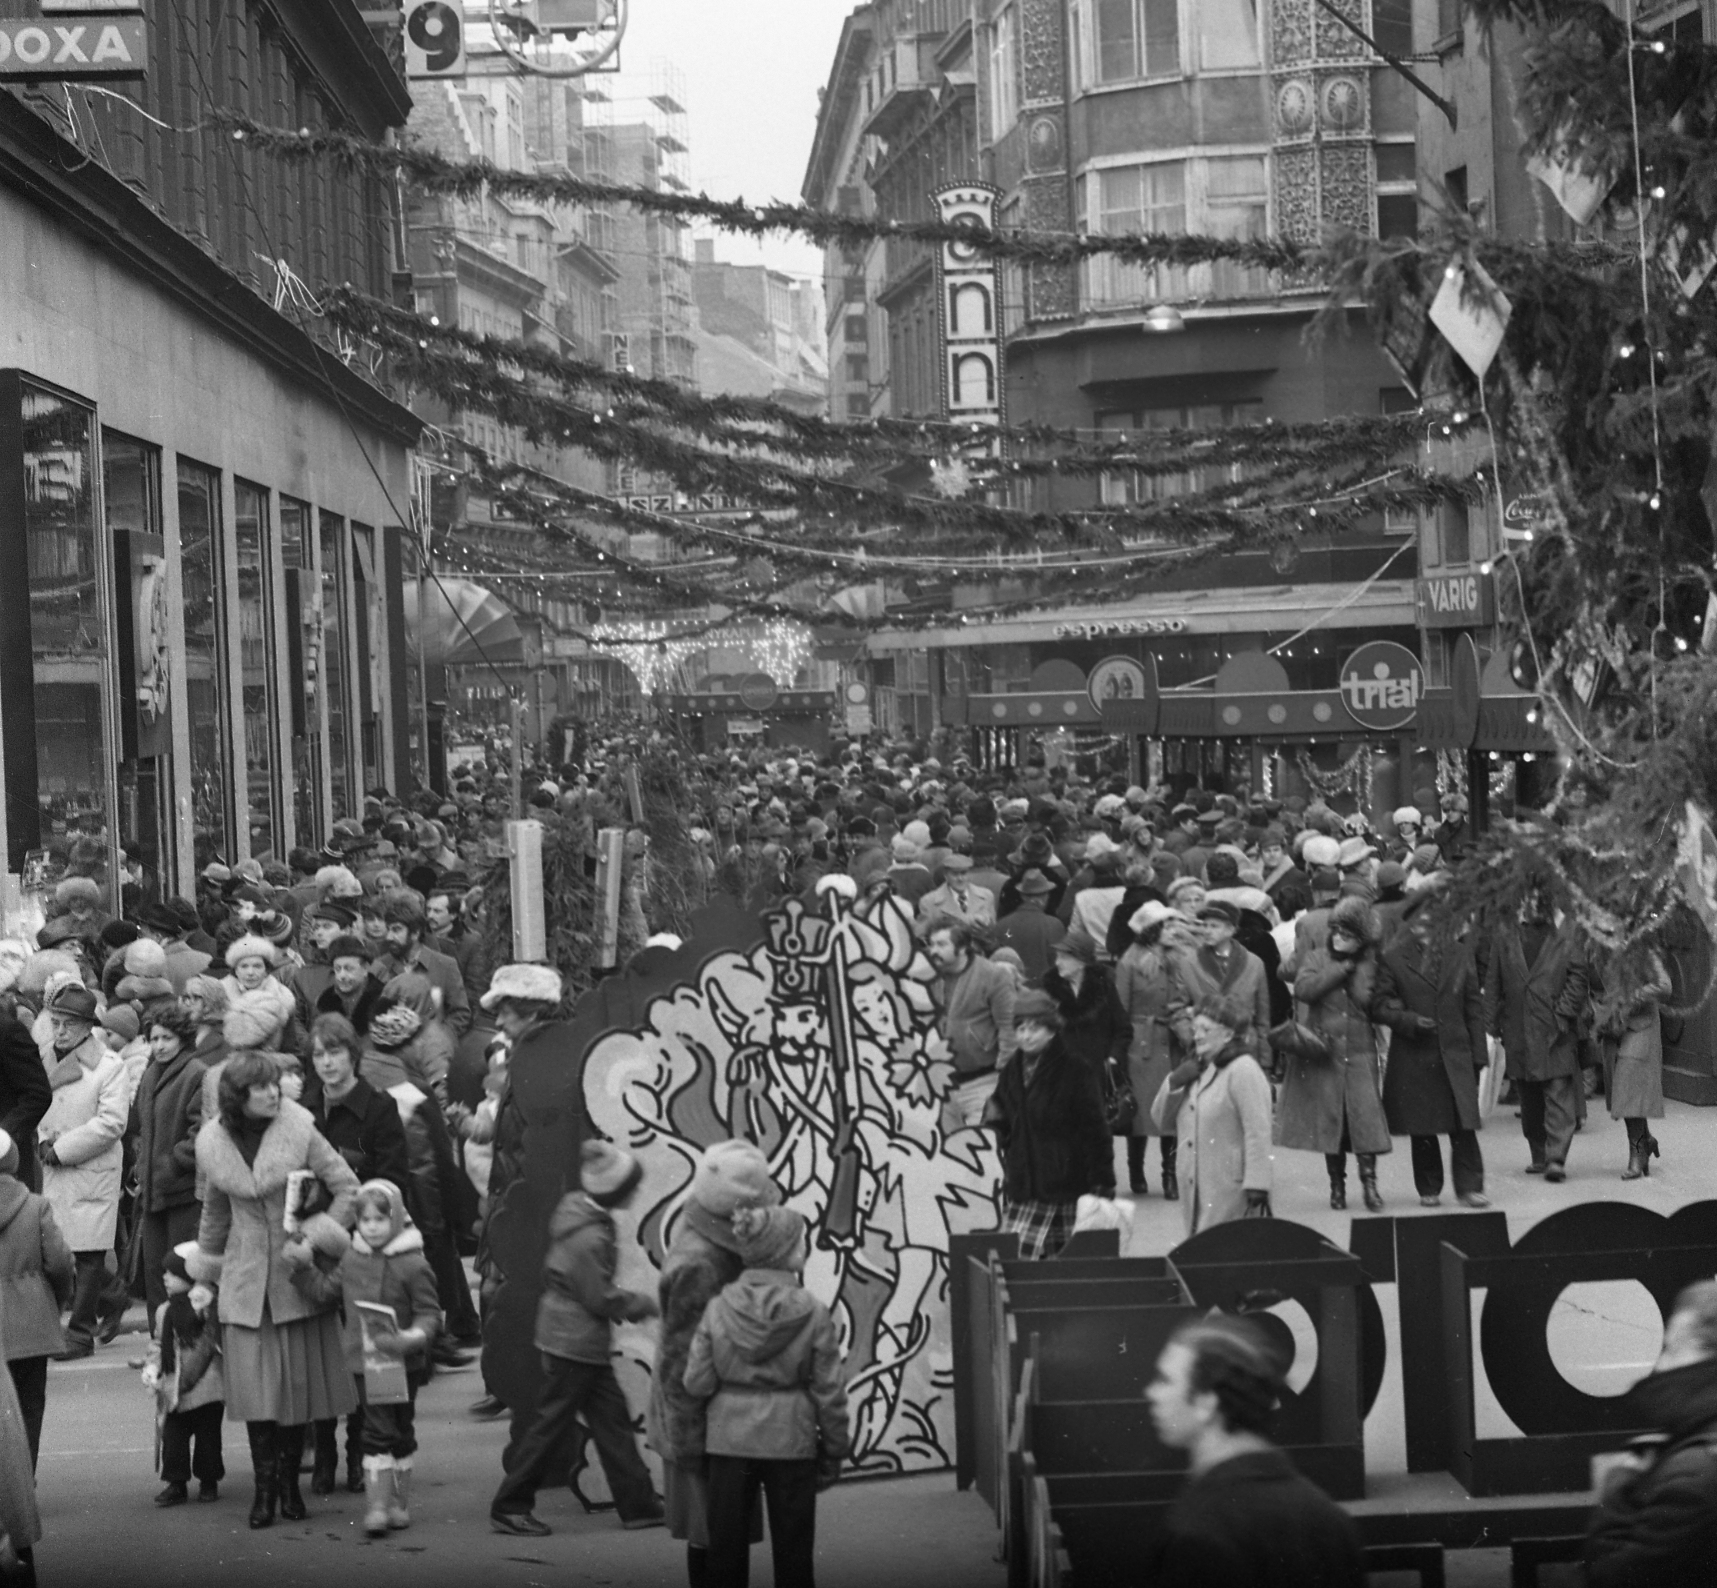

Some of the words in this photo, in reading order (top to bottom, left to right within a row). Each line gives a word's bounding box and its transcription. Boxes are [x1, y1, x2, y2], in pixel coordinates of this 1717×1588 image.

[1428, 576, 1478, 613] VARIG
[1053, 619, 1188, 640] espresso
[1341, 661, 1418, 710] trial
